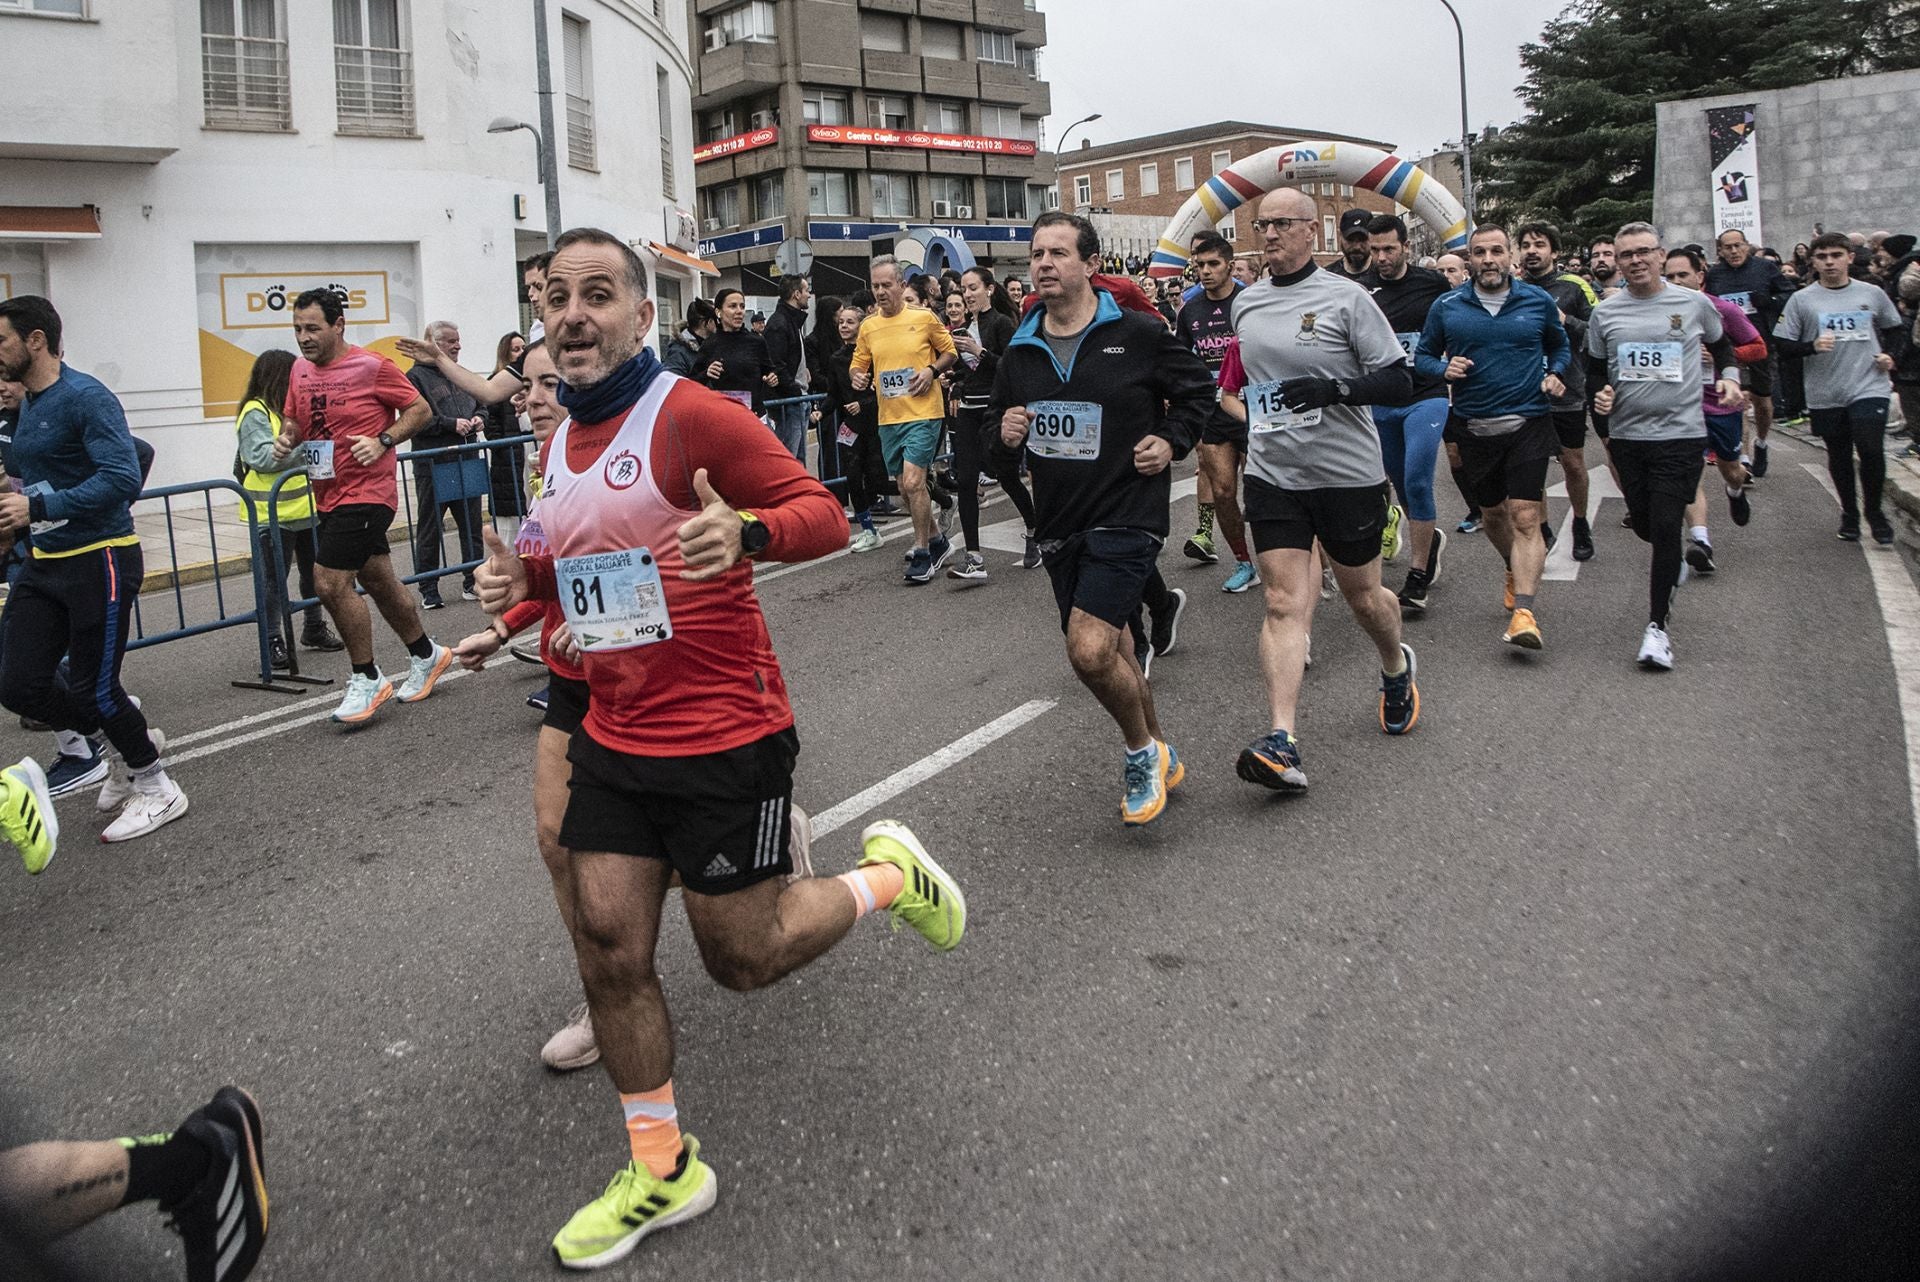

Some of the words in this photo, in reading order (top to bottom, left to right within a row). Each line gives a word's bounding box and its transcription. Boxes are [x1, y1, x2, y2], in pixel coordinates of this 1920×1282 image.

[712, 144, 723, 154] 902
[738, 138, 745, 148] 20
[847, 131, 872, 141] Centro
[874, 133, 901, 143] Capilar
[963, 139, 975, 148] 902
[994, 141, 1003, 149] 20
[1721, 218, 1754, 230] Badajoz
[1826, 318, 1856, 331] 413
[1627, 350, 1662, 367] 158
[882, 374, 904, 389] 943
[1035, 413, 1075, 438] 690
[1303, 415, 1319, 423] HOY
[573, 557, 594, 566] CROSS
[595, 552, 631, 564] POPULAR
[595, 558, 633, 571] BALUARTE
[572, 575, 605, 616] 81
[635, 622, 664, 637] HOY
